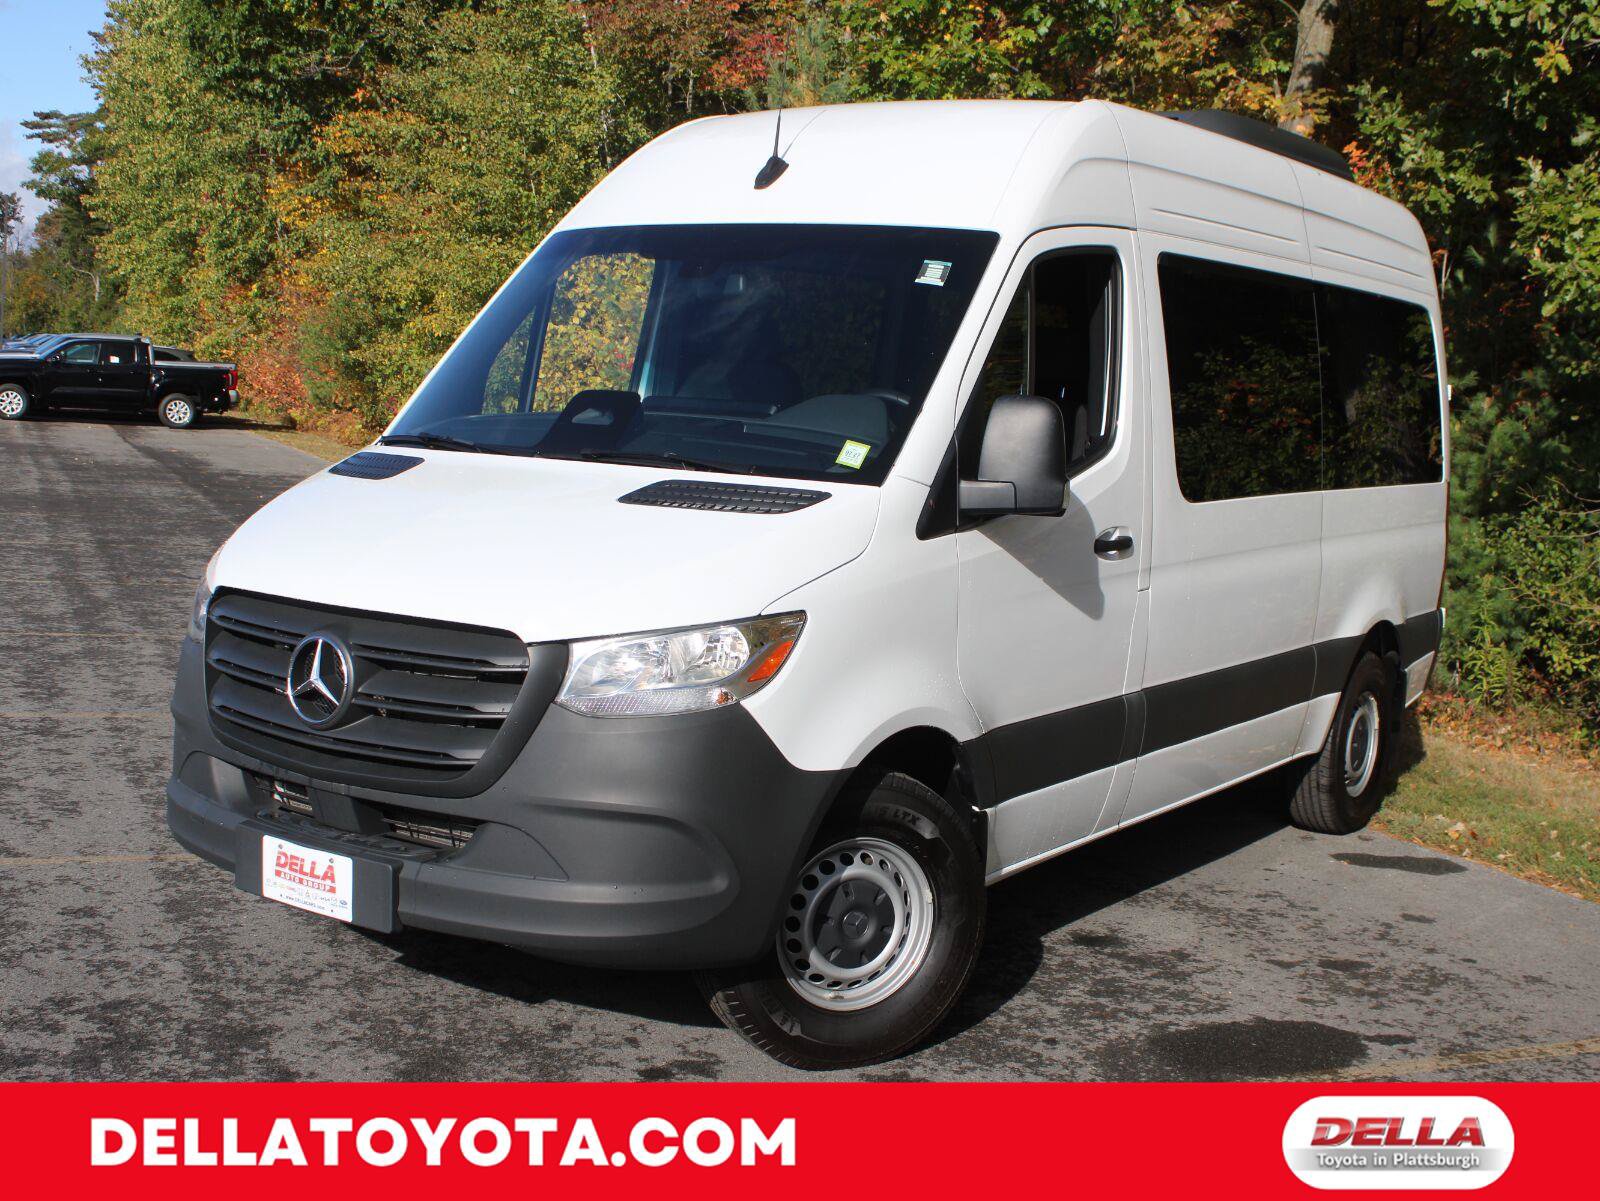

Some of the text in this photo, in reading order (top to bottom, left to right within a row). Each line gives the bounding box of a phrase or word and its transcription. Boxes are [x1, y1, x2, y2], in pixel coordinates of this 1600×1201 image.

[276, 852, 336, 883] DELLA
[280, 871, 331, 893] AUTO GROUP
